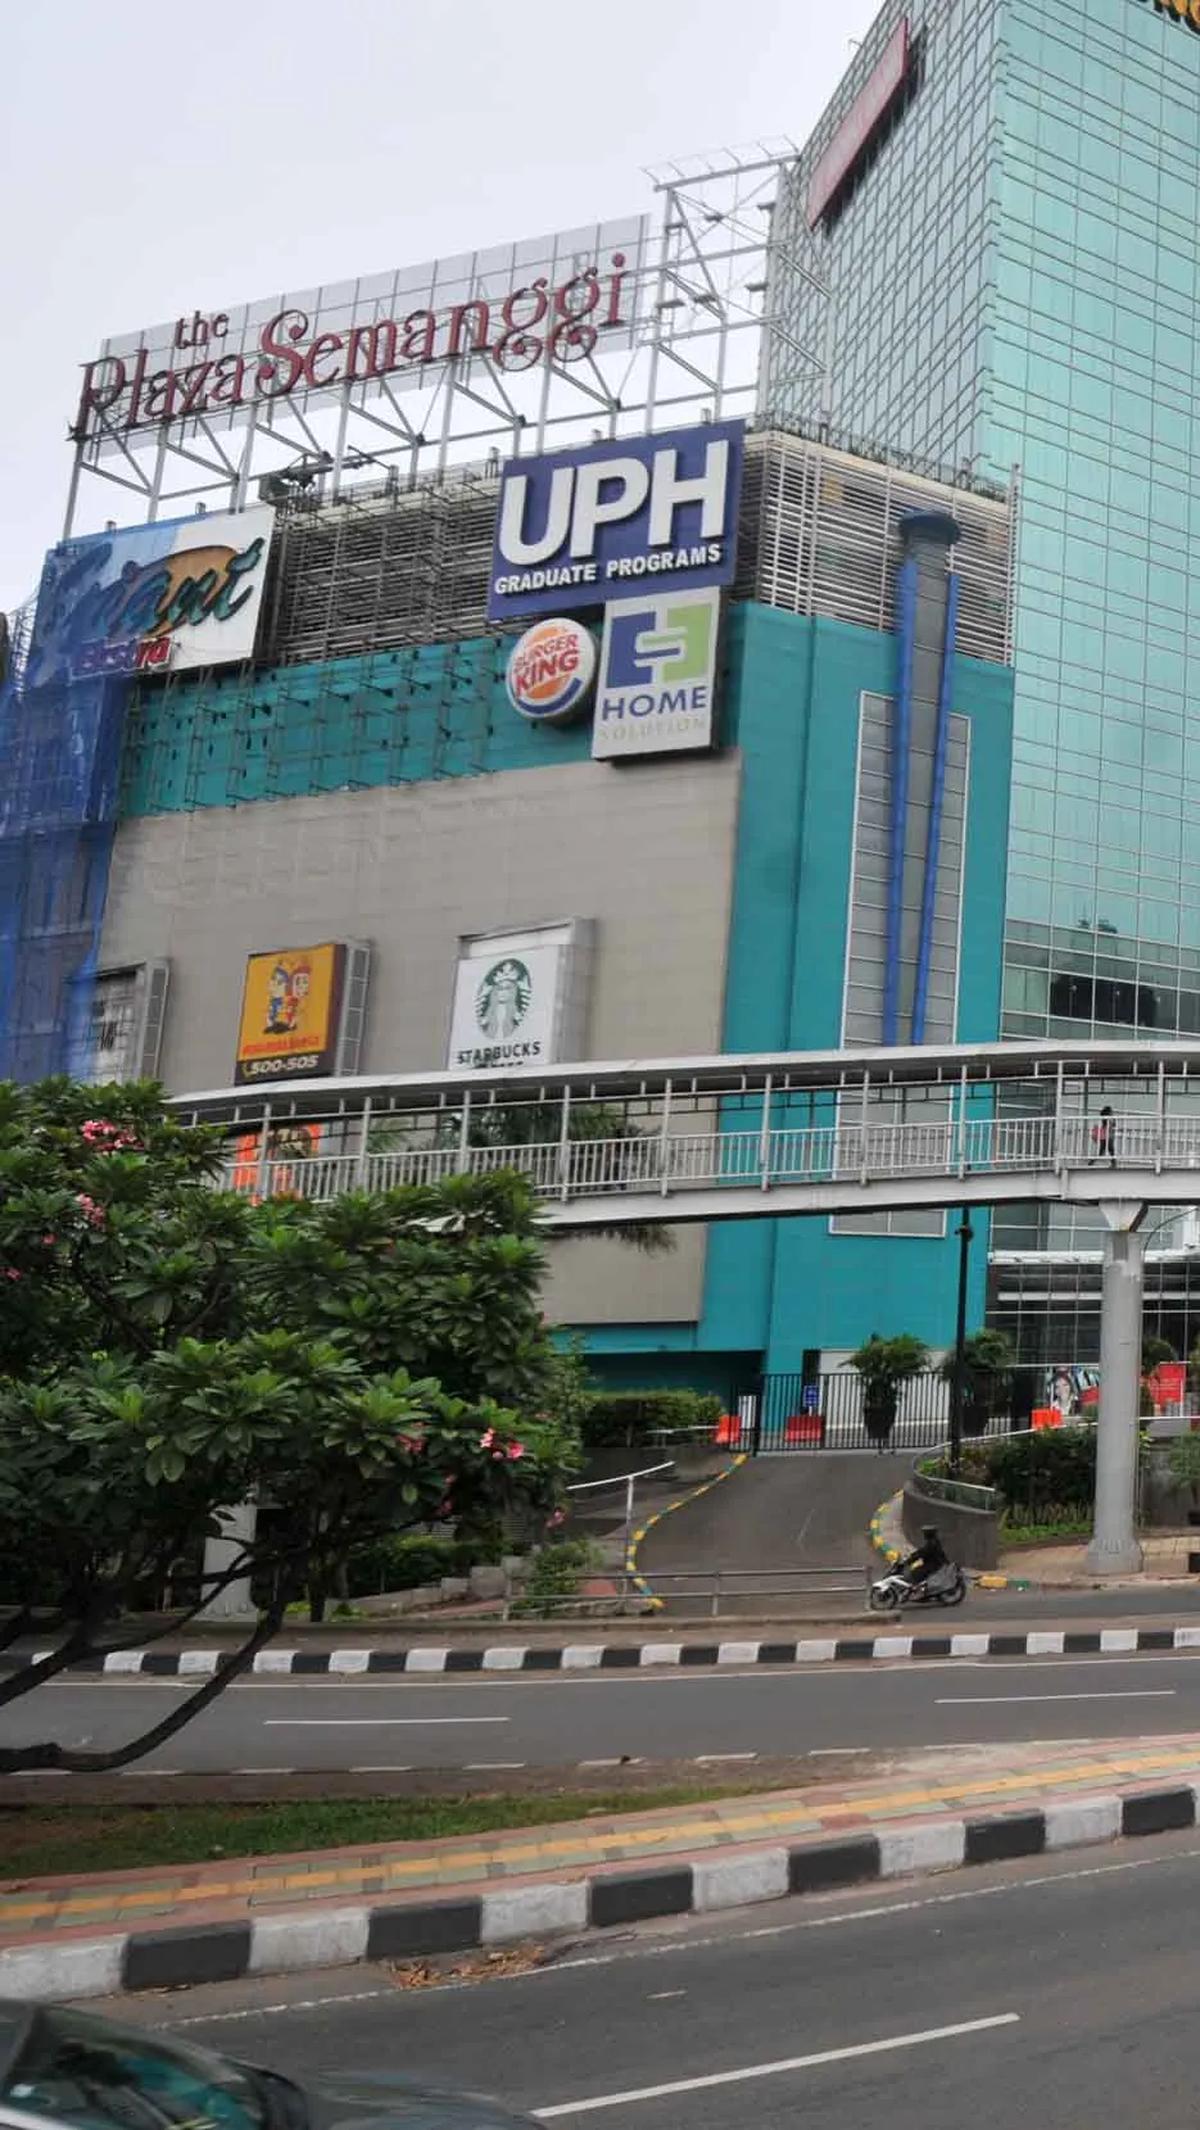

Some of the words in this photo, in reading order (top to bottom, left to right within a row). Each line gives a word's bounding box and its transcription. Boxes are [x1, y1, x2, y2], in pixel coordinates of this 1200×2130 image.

[67, 348, 245, 440] Plaza
[255, 252, 625, 398] Semanggi
[174, 310, 229, 349] the
[499, 439, 730, 566] UPH
[495, 563, 597, 595] GRADUATE
[605, 543, 722, 579] PROGRAMS
[514, 634, 578, 675] BURGER
[516, 649, 578, 698] KING
[602, 686, 707, 720] HOME
[457, 1041, 541, 1065] STARBUCKS
